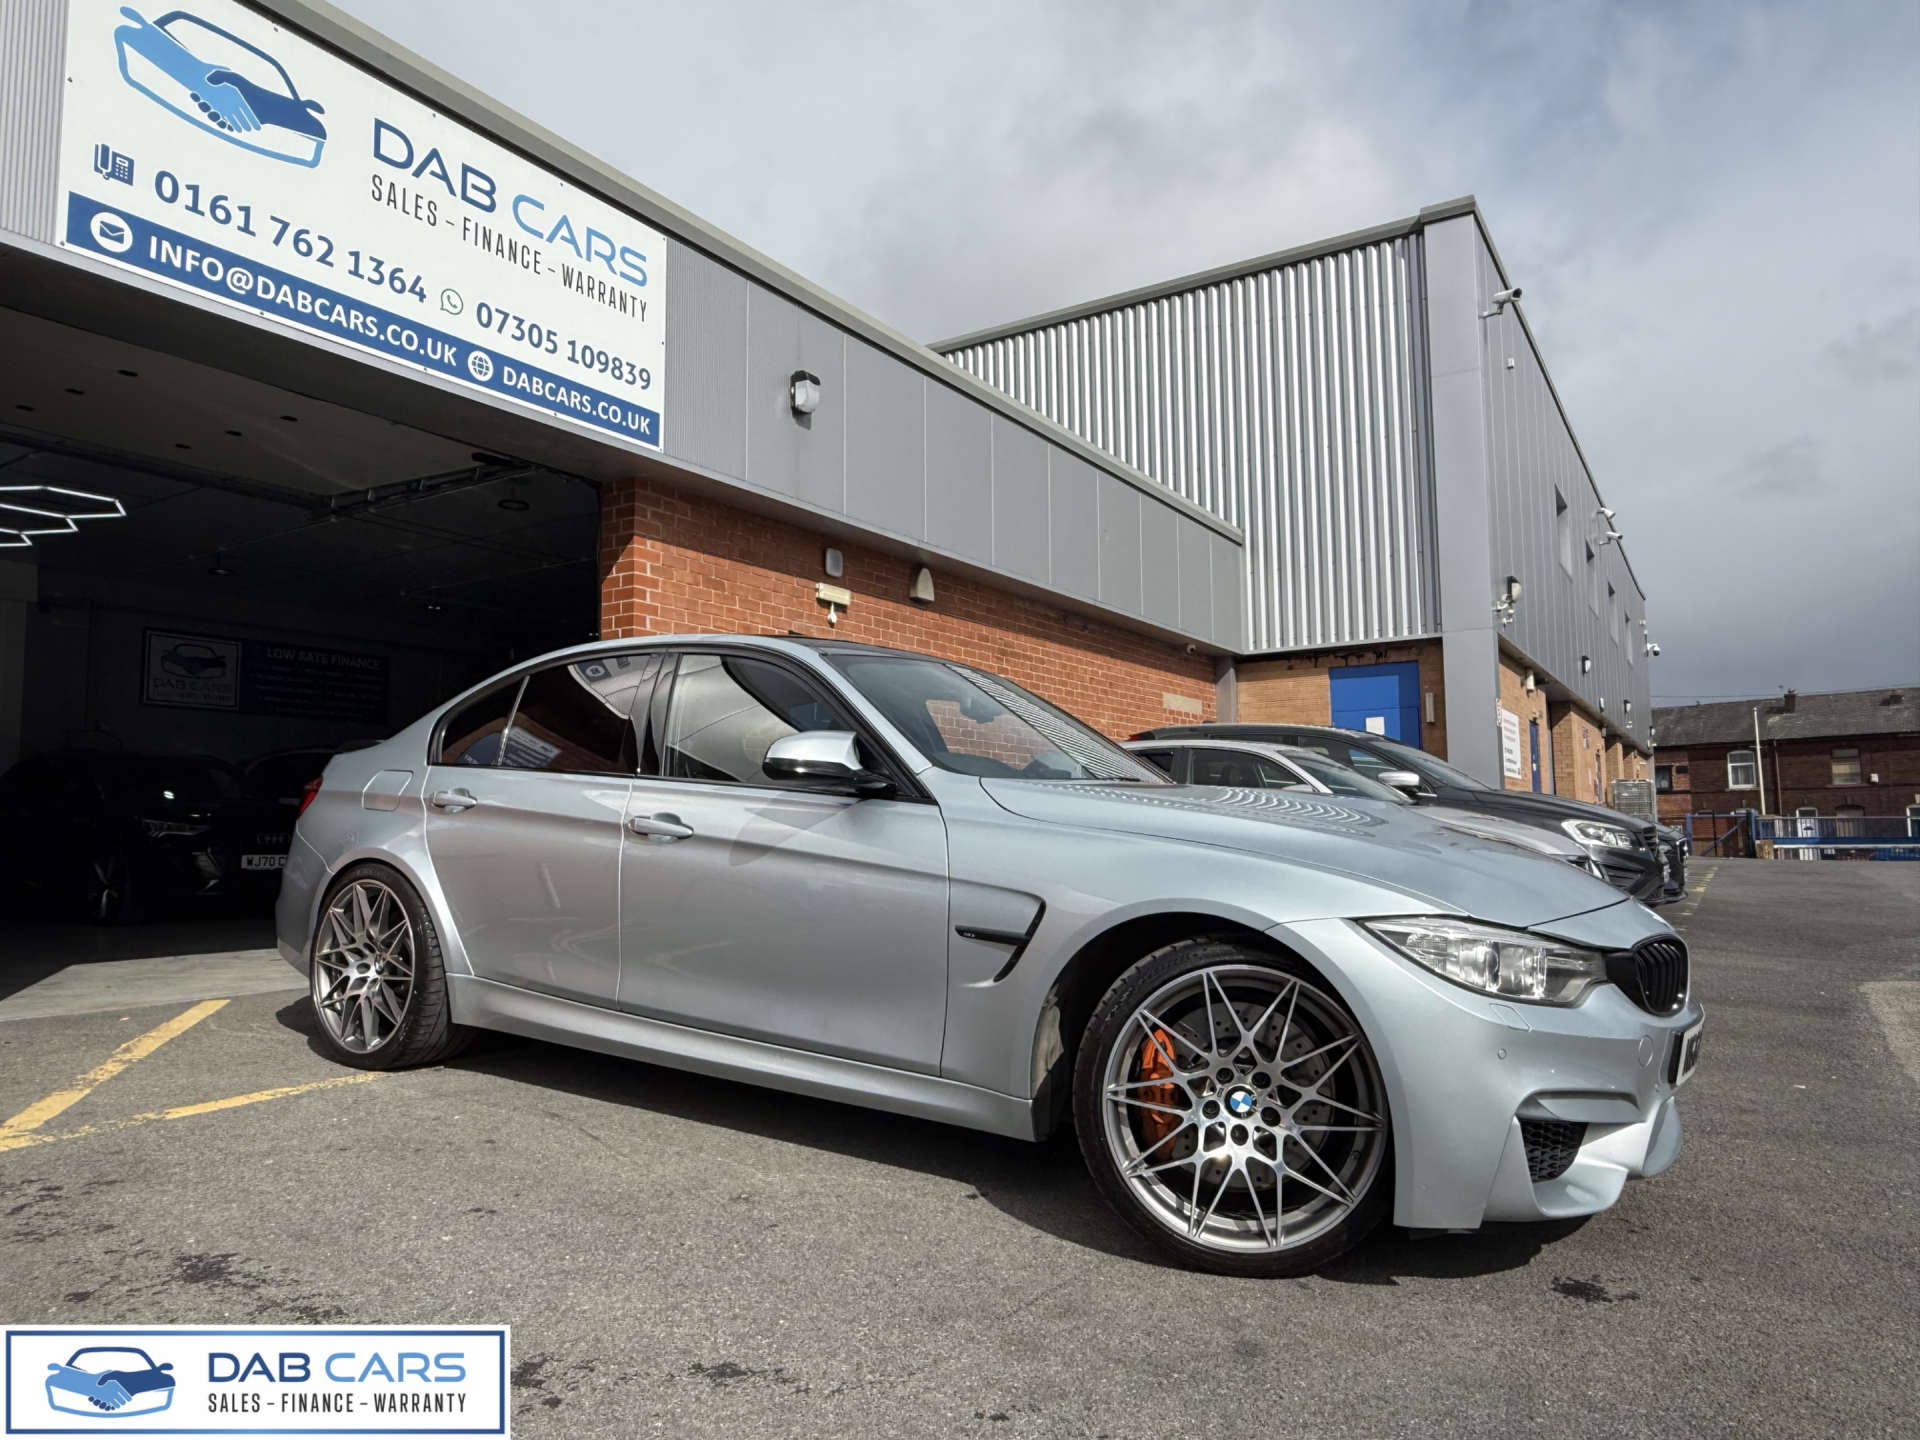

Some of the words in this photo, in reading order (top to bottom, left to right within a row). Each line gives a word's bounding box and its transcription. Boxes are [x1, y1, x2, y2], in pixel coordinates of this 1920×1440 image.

[154, 171, 257, 237] 0161
[270, 215, 334, 268] 762
[347, 250, 427, 303] 1364
[372, 174, 437, 227] SALES
[462, 216, 541, 275] FINANCE
[561, 263, 647, 322] WARRANTY
[374, 118, 497, 213] DAB
[512, 194, 647, 287] CARS
[149, 235, 457, 367] INFO@DABCARS.CO.UK
[476, 302, 558, 355] 07305
[567, 339, 651, 390] 109839
[503, 366, 650, 435] DABCARS.CO.UK
[267, 647, 296, 659] LOW
[331, 655, 380, 670] FINANCE
